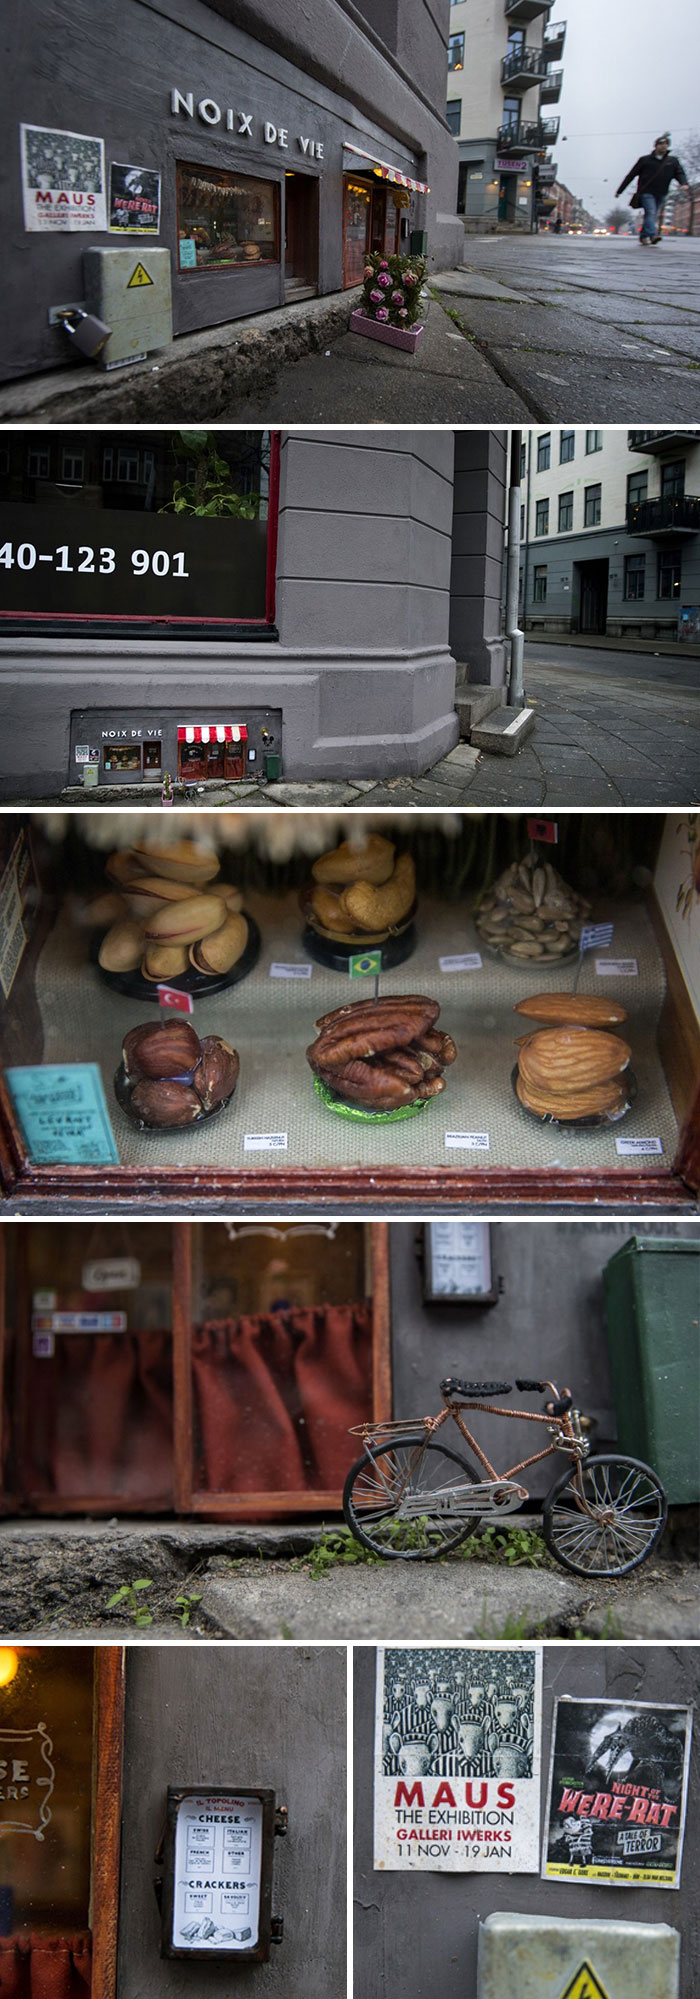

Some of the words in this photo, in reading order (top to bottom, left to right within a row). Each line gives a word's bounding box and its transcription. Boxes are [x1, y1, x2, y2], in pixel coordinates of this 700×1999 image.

[171, 87, 254, 137] NOIX
[264, 121, 289, 148] DE
[298, 135, 325, 160] VIE
[520, 162, 528, 170] 2
[35, 191, 96, 206] MAUS
[0, 542, 116, 574] 40-123
[131, 549, 190, 578] 901
[101, 730, 127, 738] NOIX
[147, 729, 163, 737] VIE
[394, 1781, 516, 1809] MAUS
[611, 1781, 650, 1797] NIGHT
[206, 1798, 245, 1807] TOPOLINO
[558, 1786, 678, 1828] WERE-RAT
[198, 1814, 241, 1824] CHEESE
[395, 1809, 423, 1824] THE
[428, 1809, 514, 1825] EXHIBITION
[396, 1828, 452, 1841] GALLERI
[457, 1829, 512, 1842] IWERKS
[624, 1831, 638, 1840] TALE
[639, 1830, 648, 1839] OF
[397, 1844, 411, 1857] 11
[418, 1844, 450, 1857] NOV
[465, 1845, 481, 1858] 19
[483, 1846, 512, 1858] JAN
[626, 1837, 659, 1853] TERROR
[188, 1880, 246, 1890] CRACKERS
